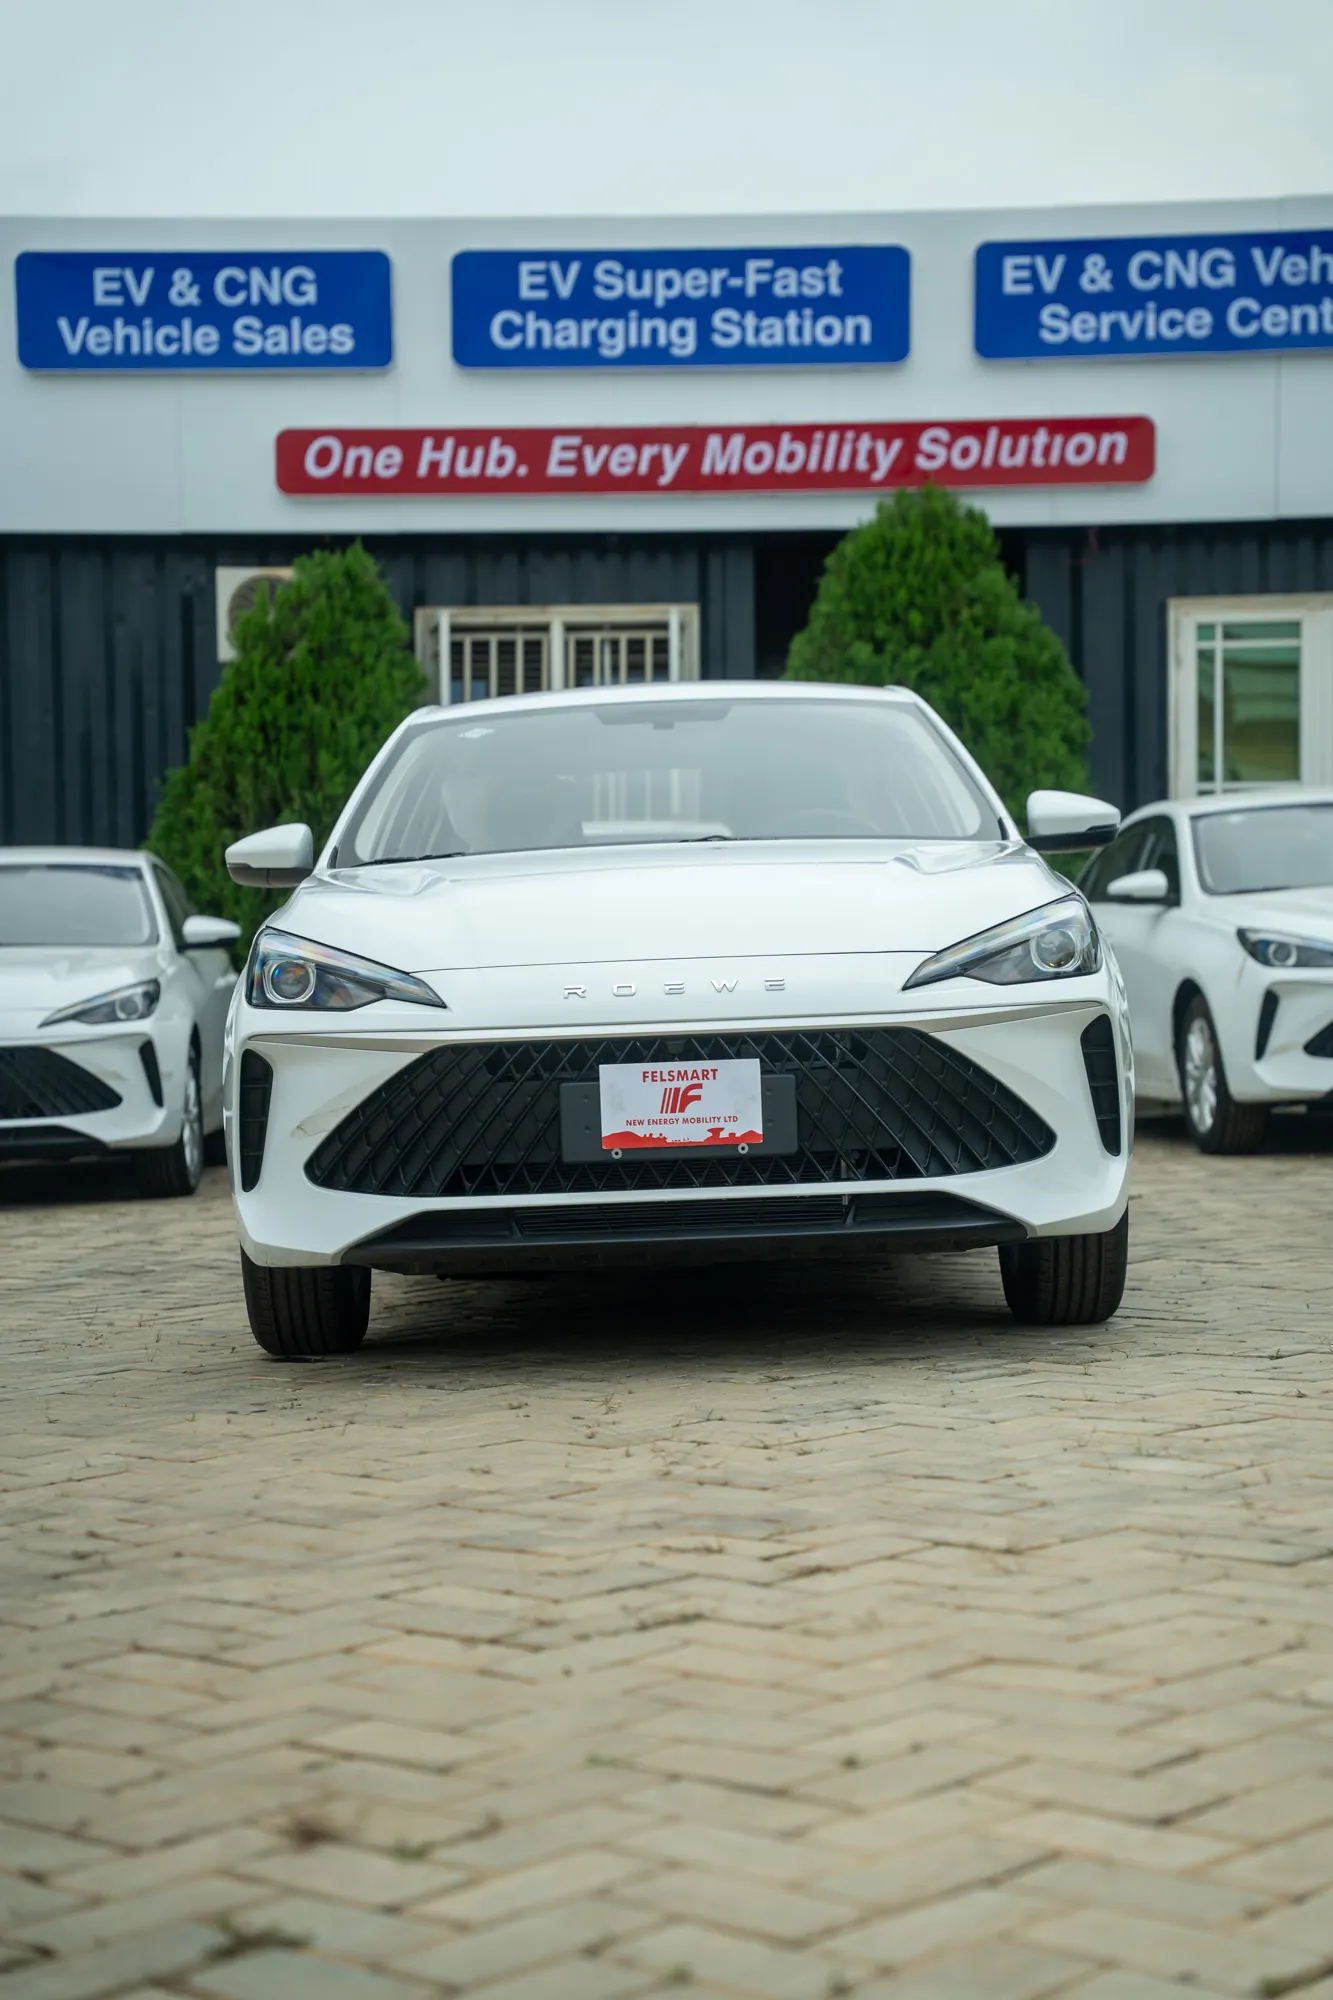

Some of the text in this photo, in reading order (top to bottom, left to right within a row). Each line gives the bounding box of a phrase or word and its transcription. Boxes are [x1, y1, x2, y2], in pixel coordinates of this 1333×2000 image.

[93, 267, 318, 307] EV & CNG
[517, 258, 844, 307] EV Super-Fast
[1001, 254, 1067, 295] EV
[1080, 253, 1114, 293] &
[1127, 249, 1237, 290] CNG
[57, 316, 355, 356] Vehicle Sales
[489, 307, 873, 358] Charging Station
[1039, 302, 1214, 344] Service
[303, 426, 1128, 487] One Hub. Every Mobility Solution
[563, 976, 786, 999] ROEWE
[641, 1068, 719, 1083] FELSMART
[625, 1115, 739, 1127] NEW ENERGY MOBILITY LTD
